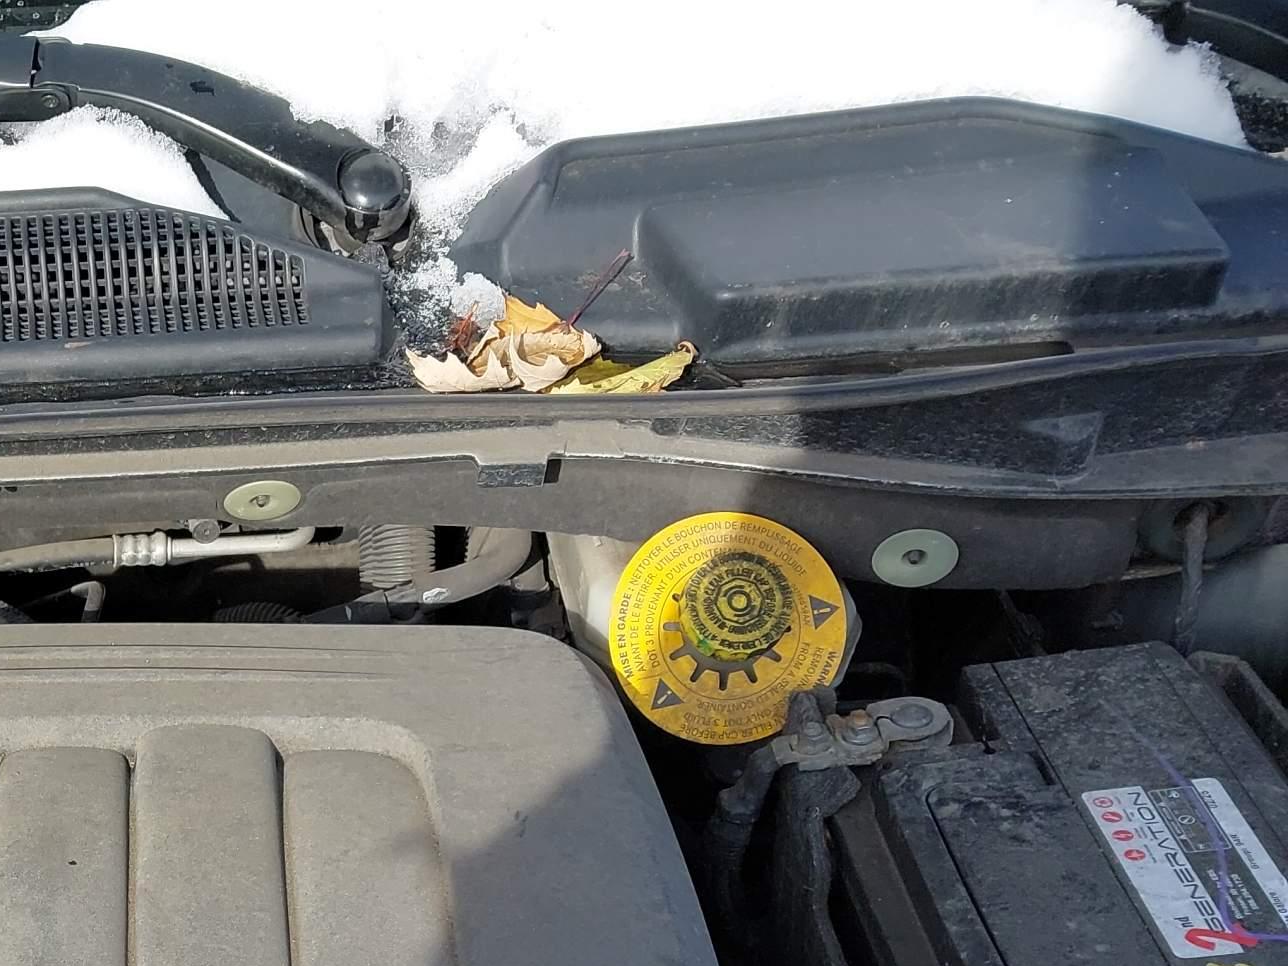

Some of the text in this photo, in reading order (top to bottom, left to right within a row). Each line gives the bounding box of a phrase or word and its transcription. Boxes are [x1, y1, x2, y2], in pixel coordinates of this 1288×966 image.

[675, 521, 721, 542] BOUCHON
[724, 521, 738, 530] DE
[663, 536, 675, 549] LE
[690, 533, 755, 550] UNIQUEMENT
[758, 539, 773, 552] DU
[630, 545, 663, 584] NETTOYER
[655, 543, 691, 572] UTILISER
[617, 593, 632, 630] GARDE
[645, 579, 666, 636] PROVENANT
[617, 634, 627, 648] EN
[630, 625, 638, 638] DE
[618, 651, 635, 679] MISE
[630, 641, 646, 672] AVANT
[647, 649, 661, 668] DOT
[793, 642, 810, 670] FROM
[1127, 791, 1225, 932] GENERATION
